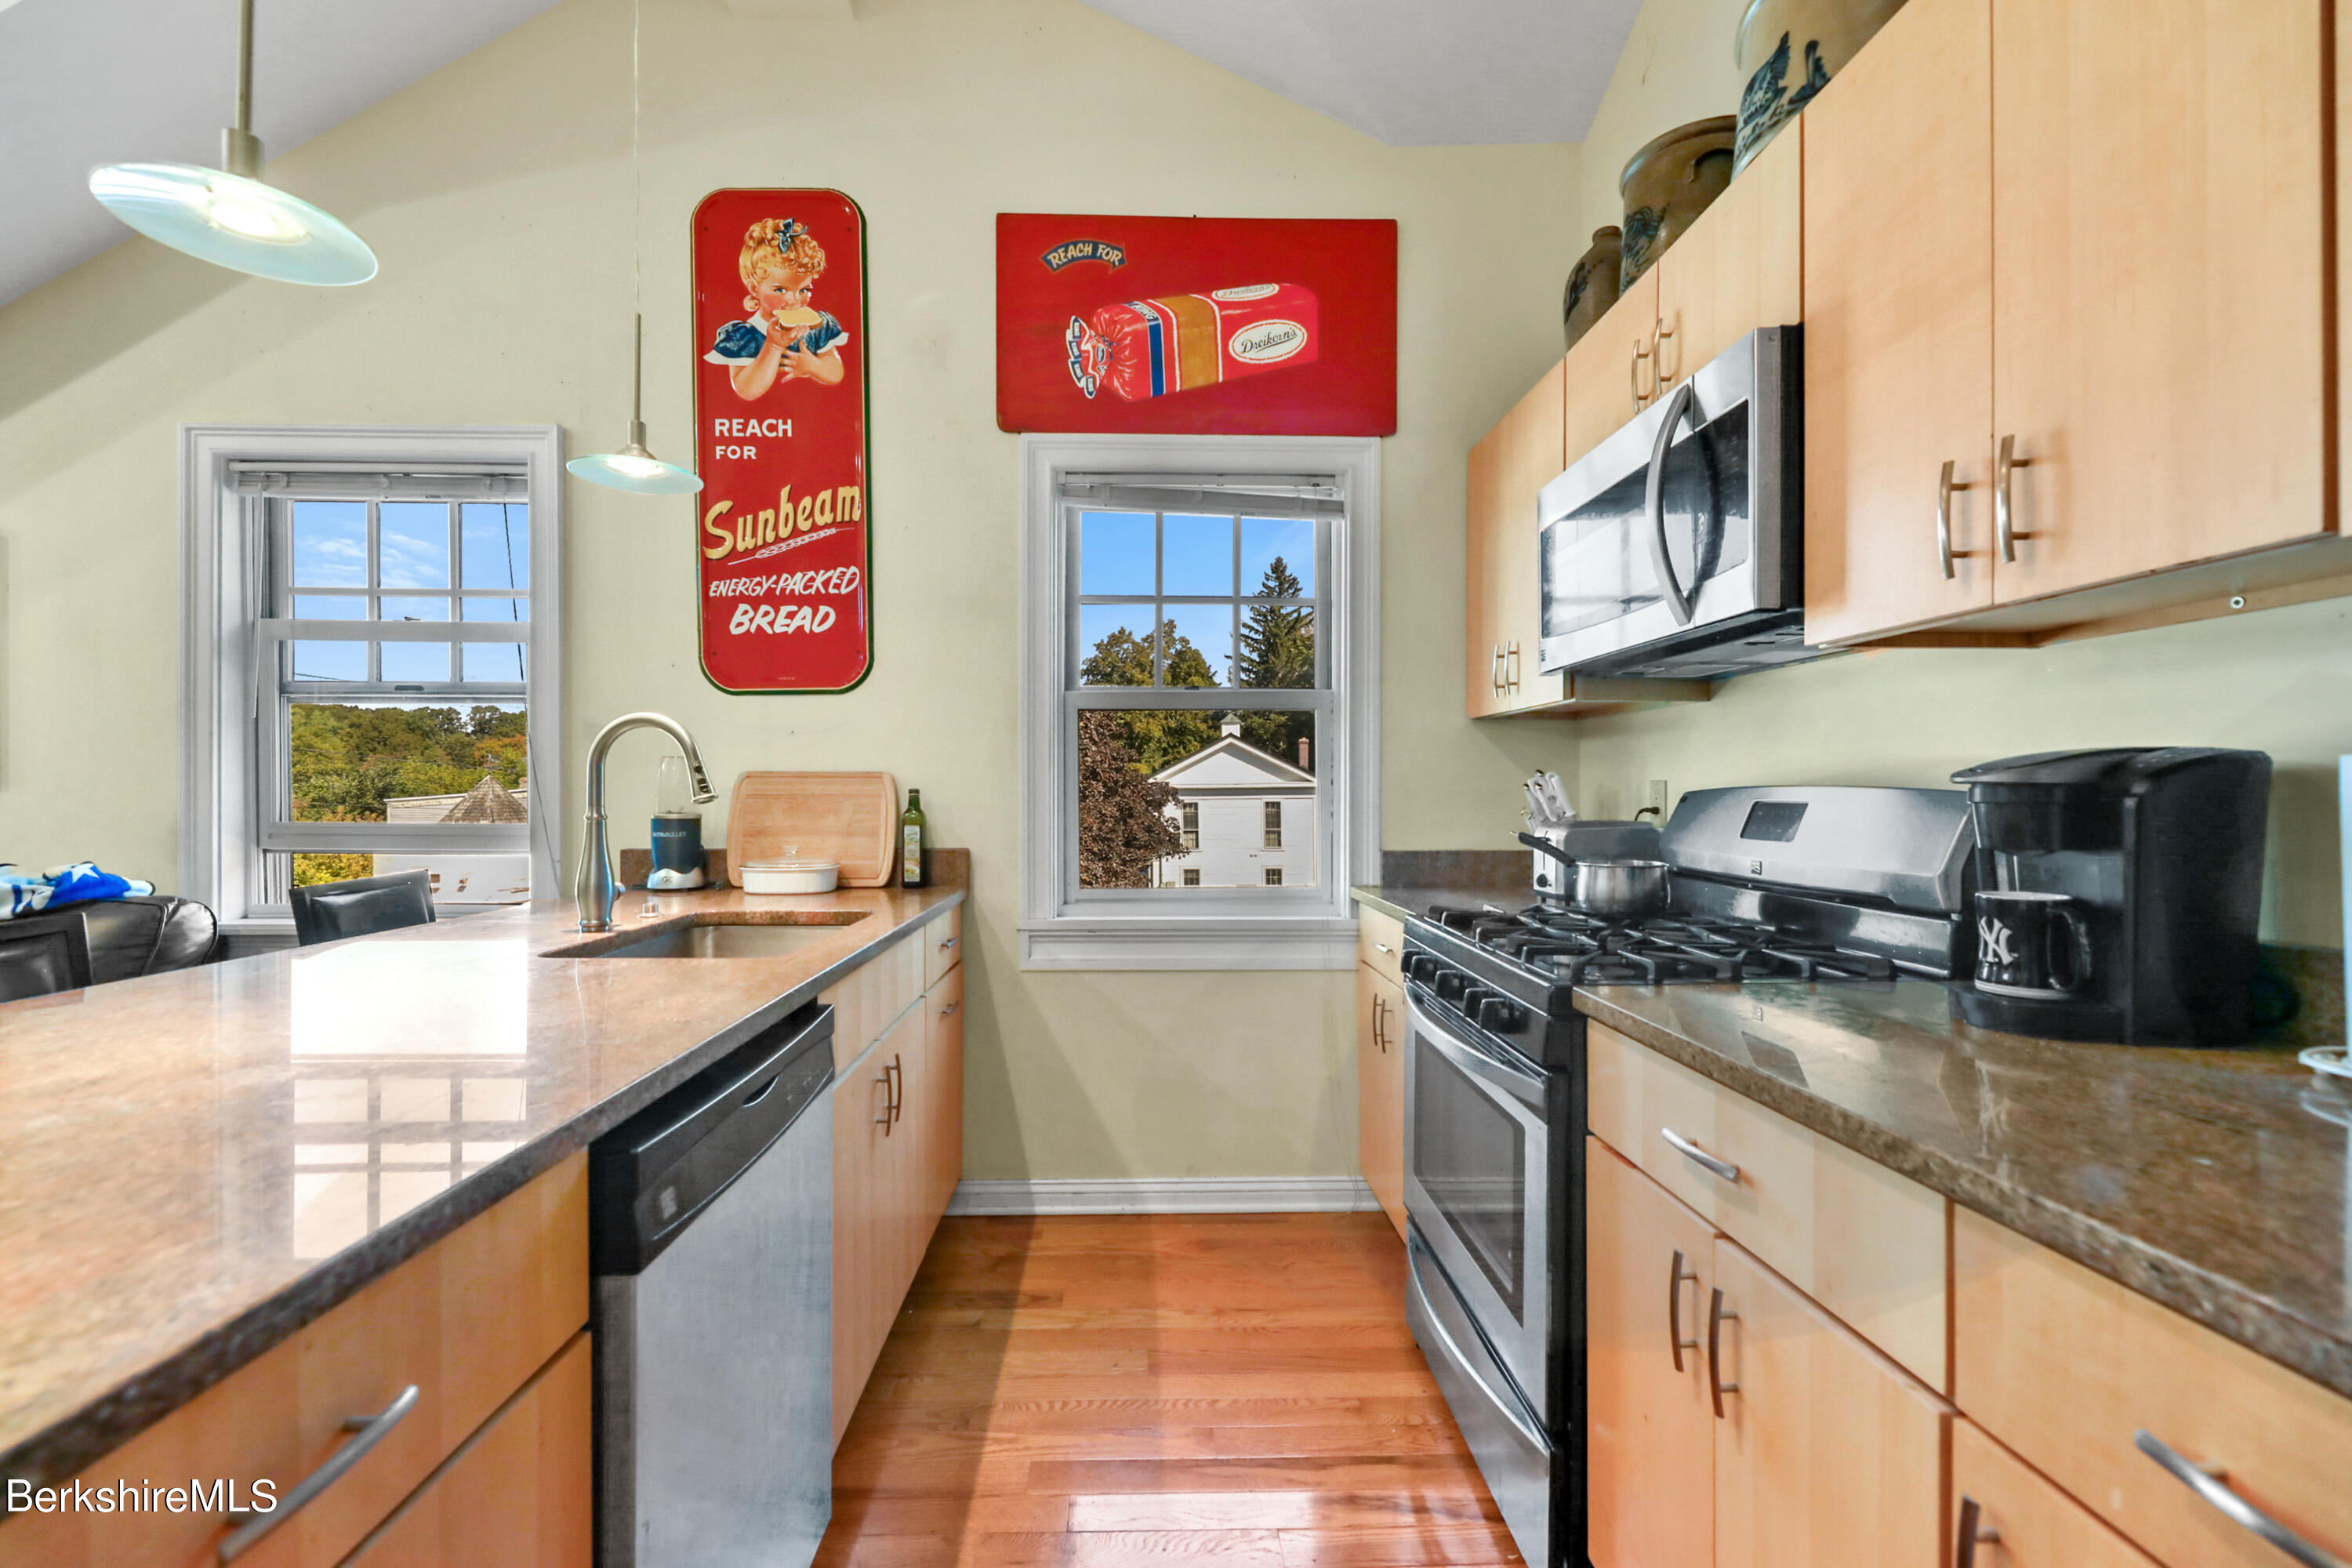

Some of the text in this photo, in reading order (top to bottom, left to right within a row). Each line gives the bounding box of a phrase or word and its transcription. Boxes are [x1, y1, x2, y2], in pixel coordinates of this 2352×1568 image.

[1047, 243, 1122, 268] REACH FOR
[1131, 304, 1157, 320] KING
[1240, 327, 1298, 354] Dreikorn's
[714, 418, 793, 437] REACH
[715, 445, 757, 459] FOR
[703, 484, 862, 561] Sunbeam
[709, 565, 860, 597] ENERGY-PACKED
[729, 603, 836, 635] BREAD
[1976, 915, 2014, 966] NY
